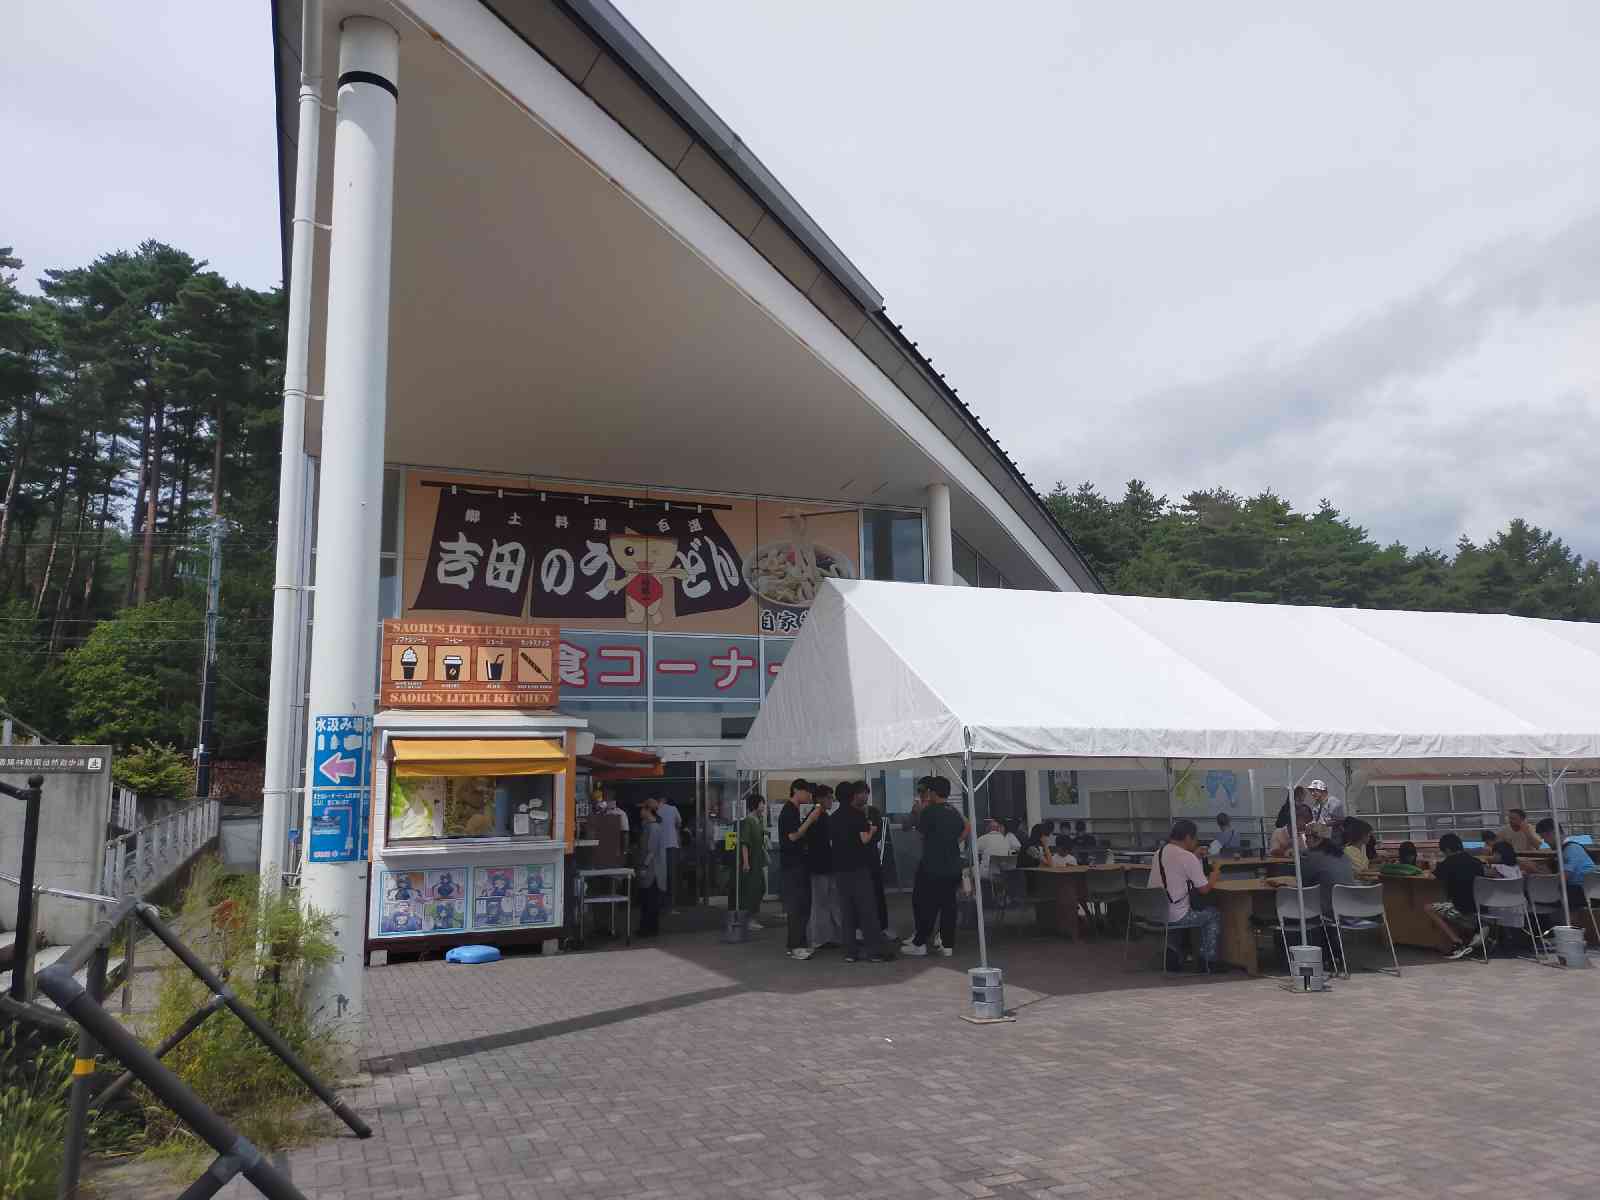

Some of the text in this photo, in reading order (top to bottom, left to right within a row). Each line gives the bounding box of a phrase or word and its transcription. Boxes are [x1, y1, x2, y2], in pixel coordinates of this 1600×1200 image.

[436, 531, 740, 600] 吉田のうどん
[390, 692, 442, 704] SAORI'S
